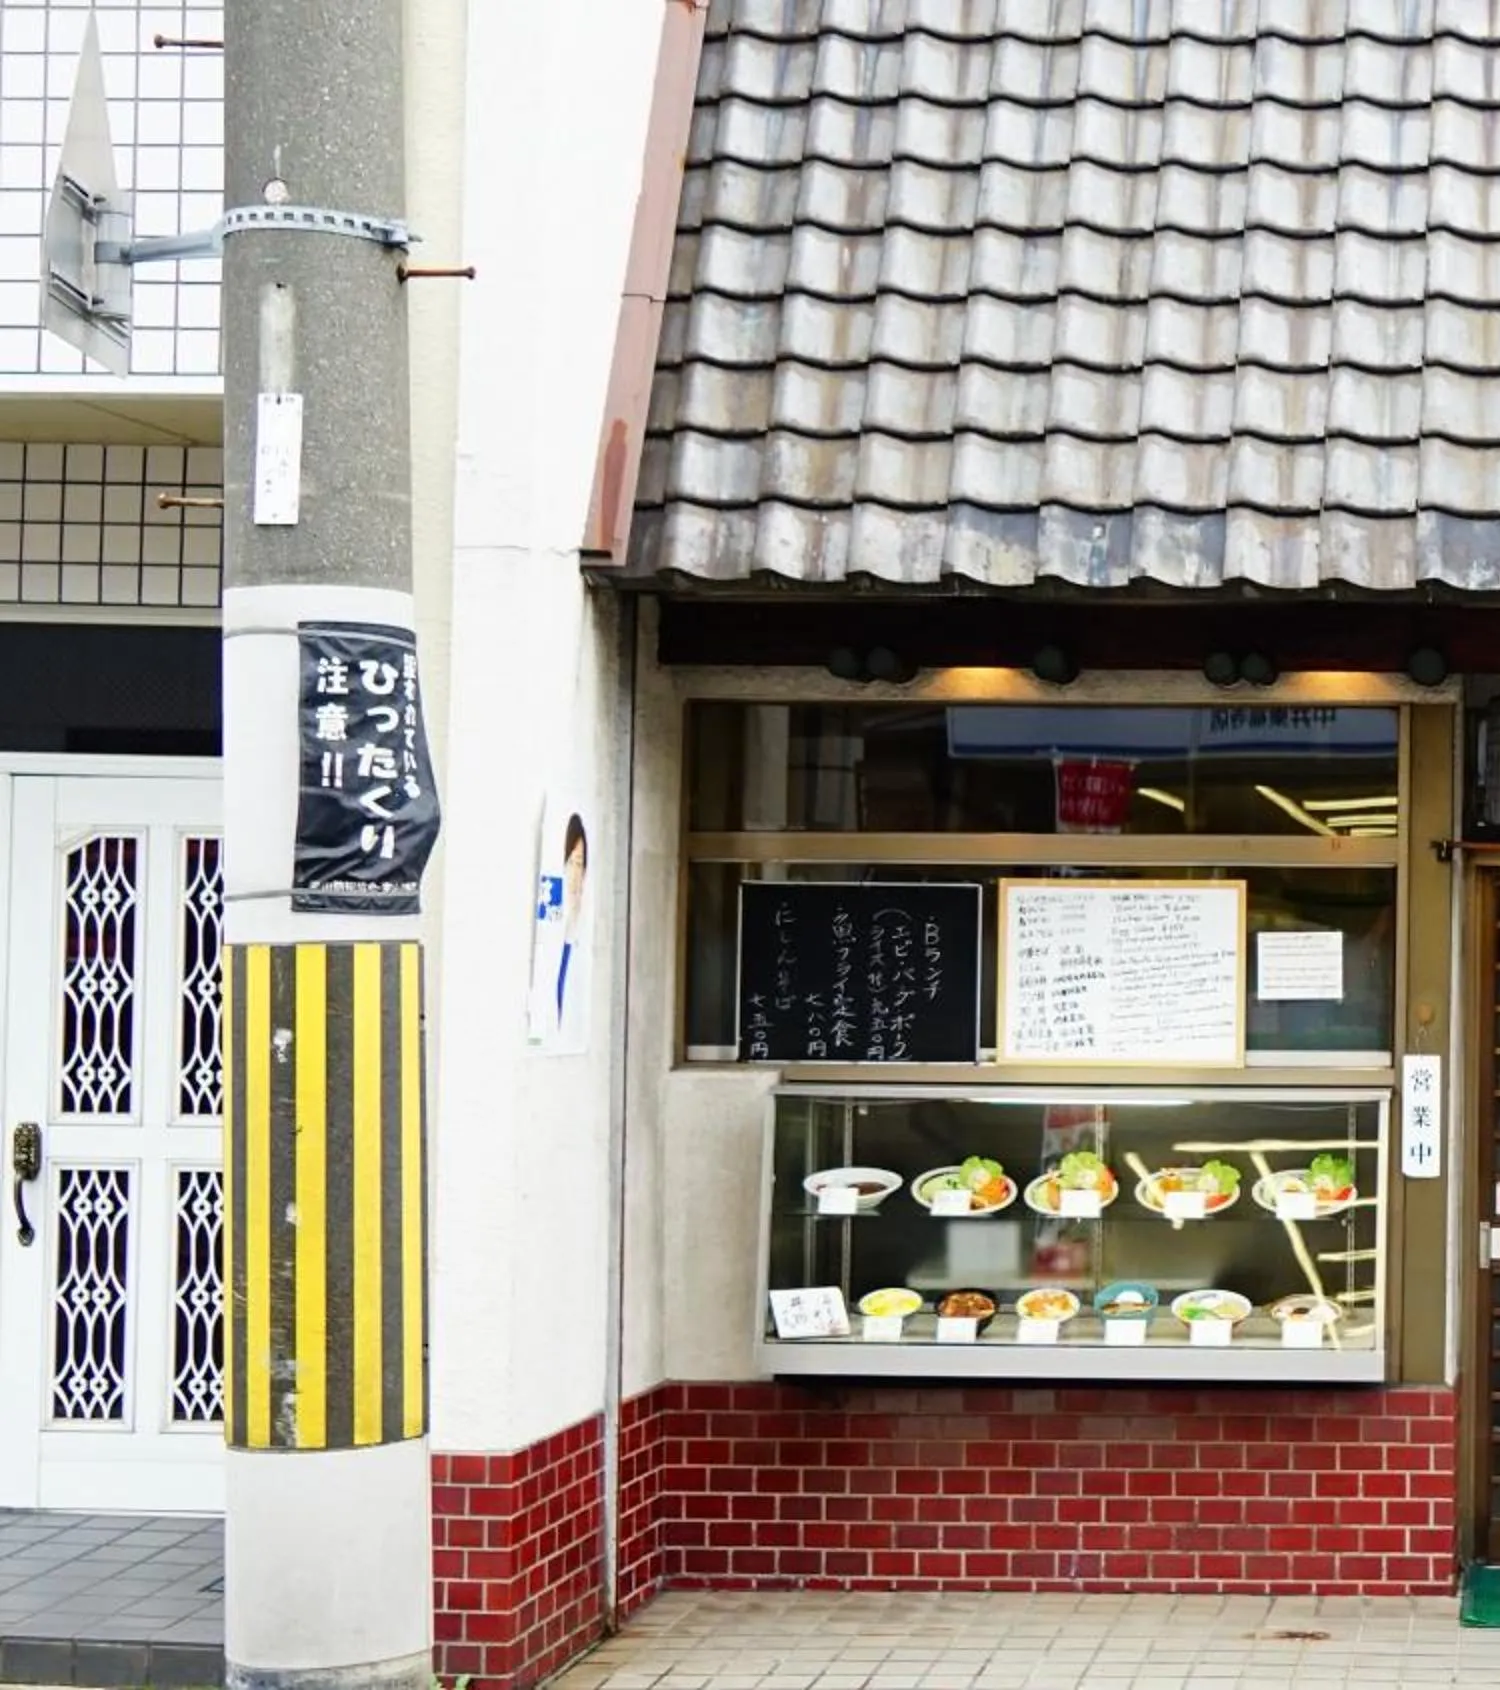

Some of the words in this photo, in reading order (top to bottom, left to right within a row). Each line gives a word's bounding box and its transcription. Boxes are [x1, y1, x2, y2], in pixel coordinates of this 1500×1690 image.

[357, 659, 399, 859] ひったくり
[1411, 1068, 1433, 1165] 営業中
